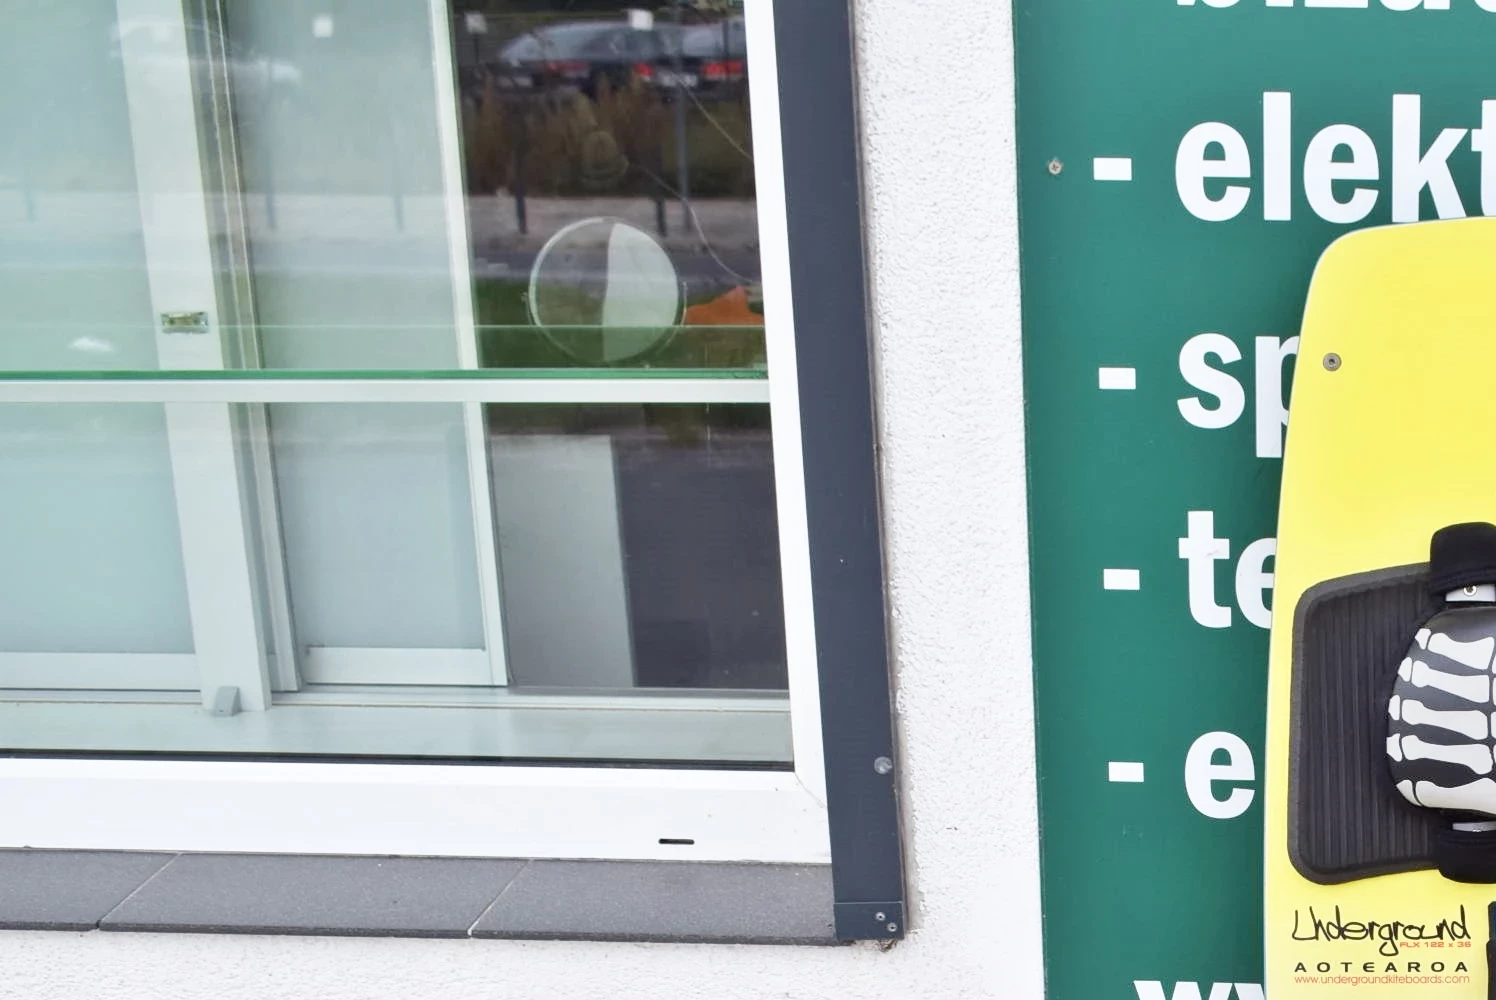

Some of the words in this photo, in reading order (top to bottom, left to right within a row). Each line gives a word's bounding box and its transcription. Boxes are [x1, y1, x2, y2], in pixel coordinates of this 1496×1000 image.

[1291, 904, 1471, 957] Underground
[1399, 941, 1420, 949] FLX
[1425, 941, 1445, 949] 122
[1294, 961, 1468, 973] AOTEAROA
[1294, 974, 1470, 986] www.undergroundkiteboards.com
